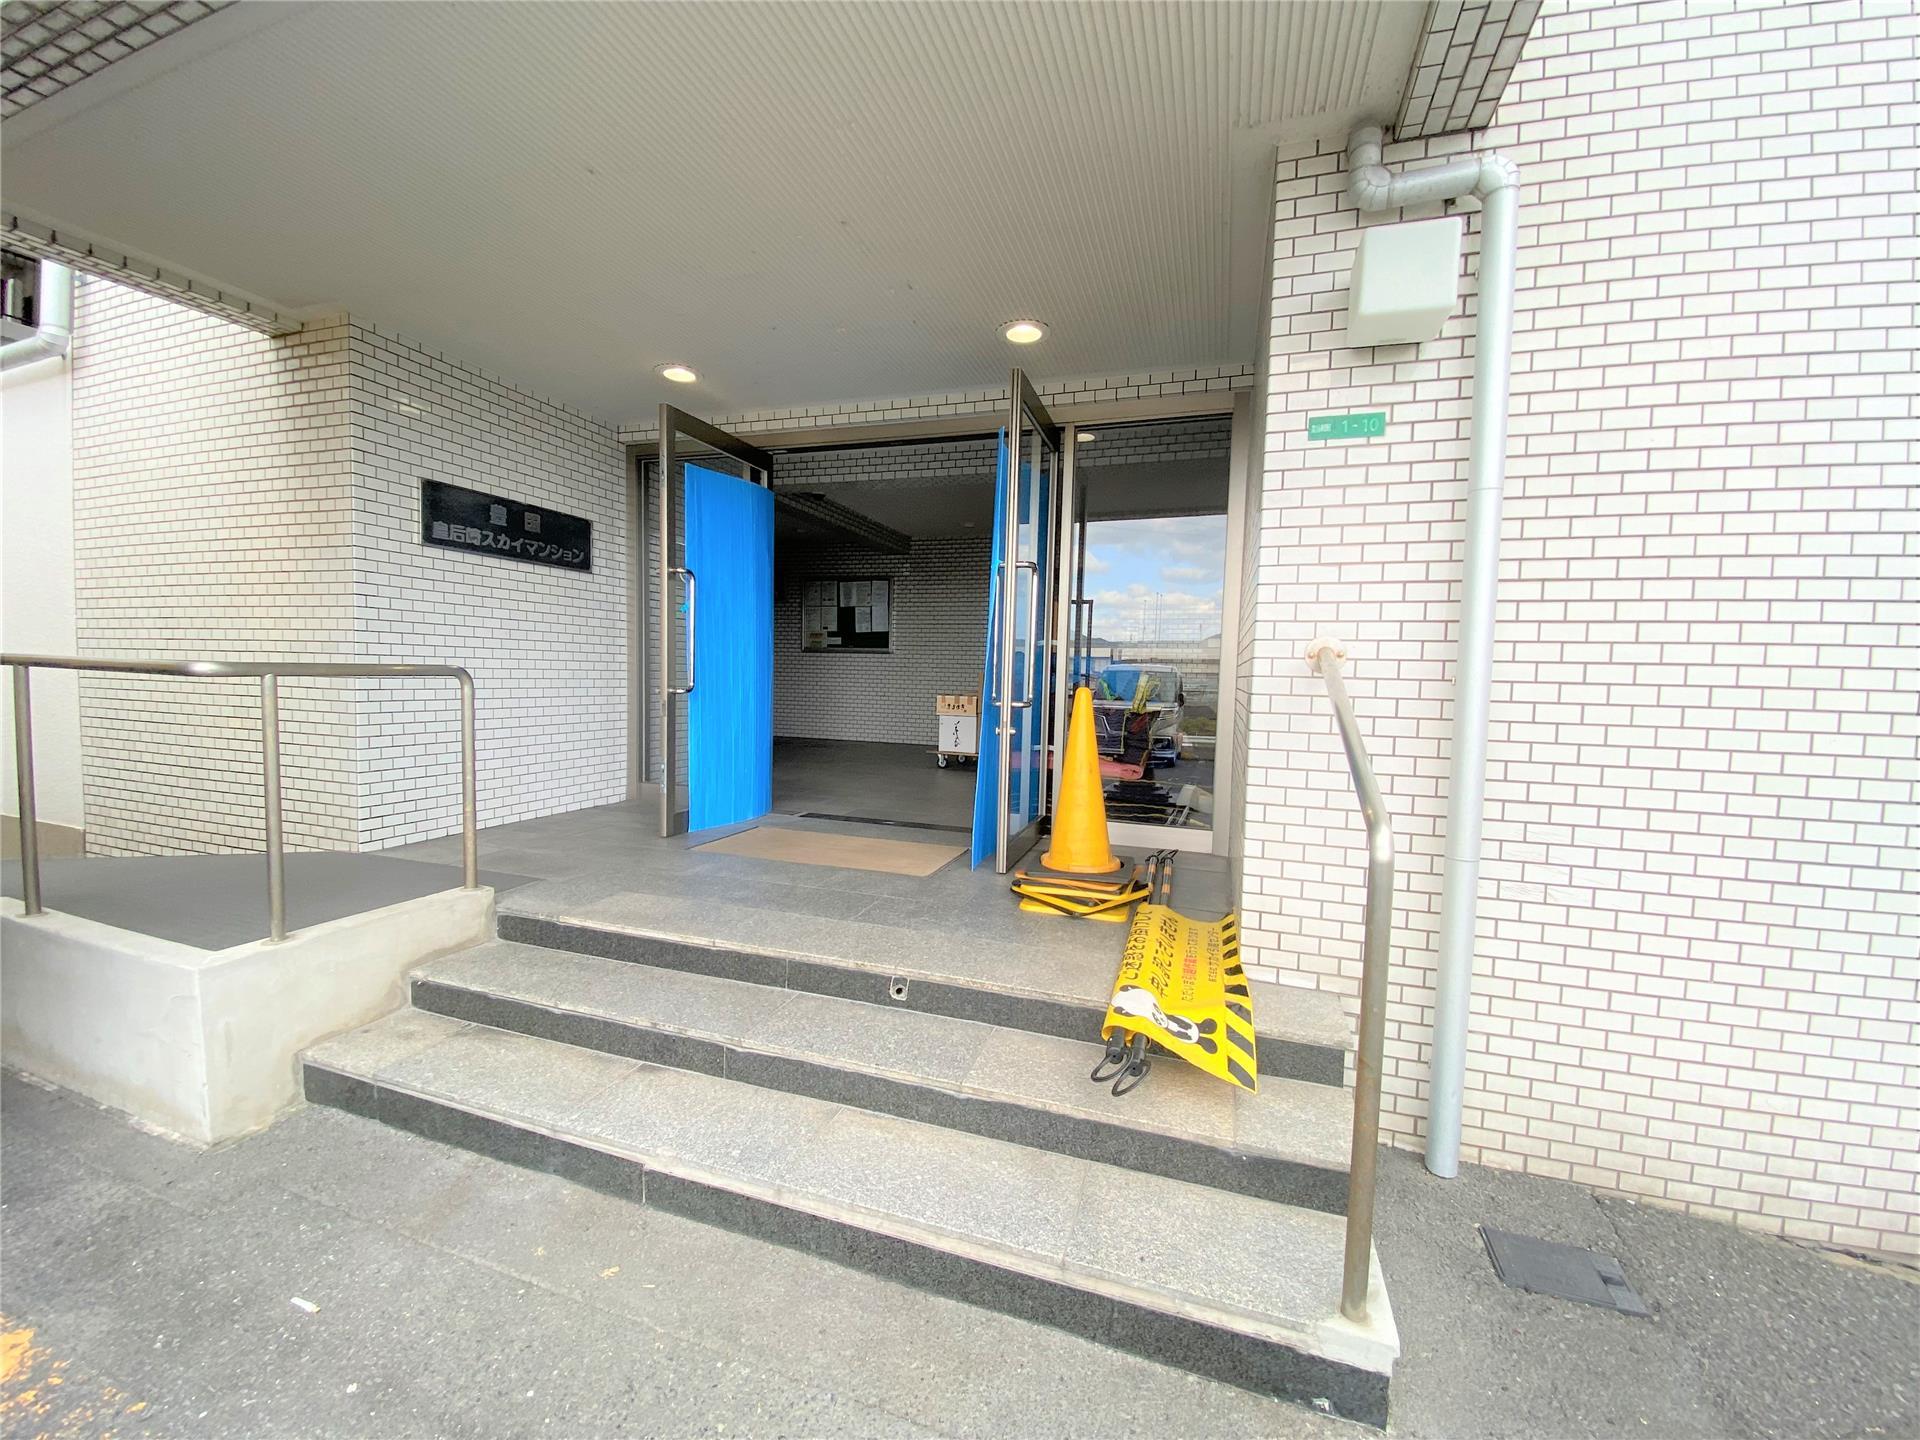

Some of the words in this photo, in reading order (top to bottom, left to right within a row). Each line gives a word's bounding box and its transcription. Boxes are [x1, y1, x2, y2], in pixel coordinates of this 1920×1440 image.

[432, 520, 585, 563] 皇后崎スカイマンション
[1149, 915, 1179, 999] 申し訳ございません
